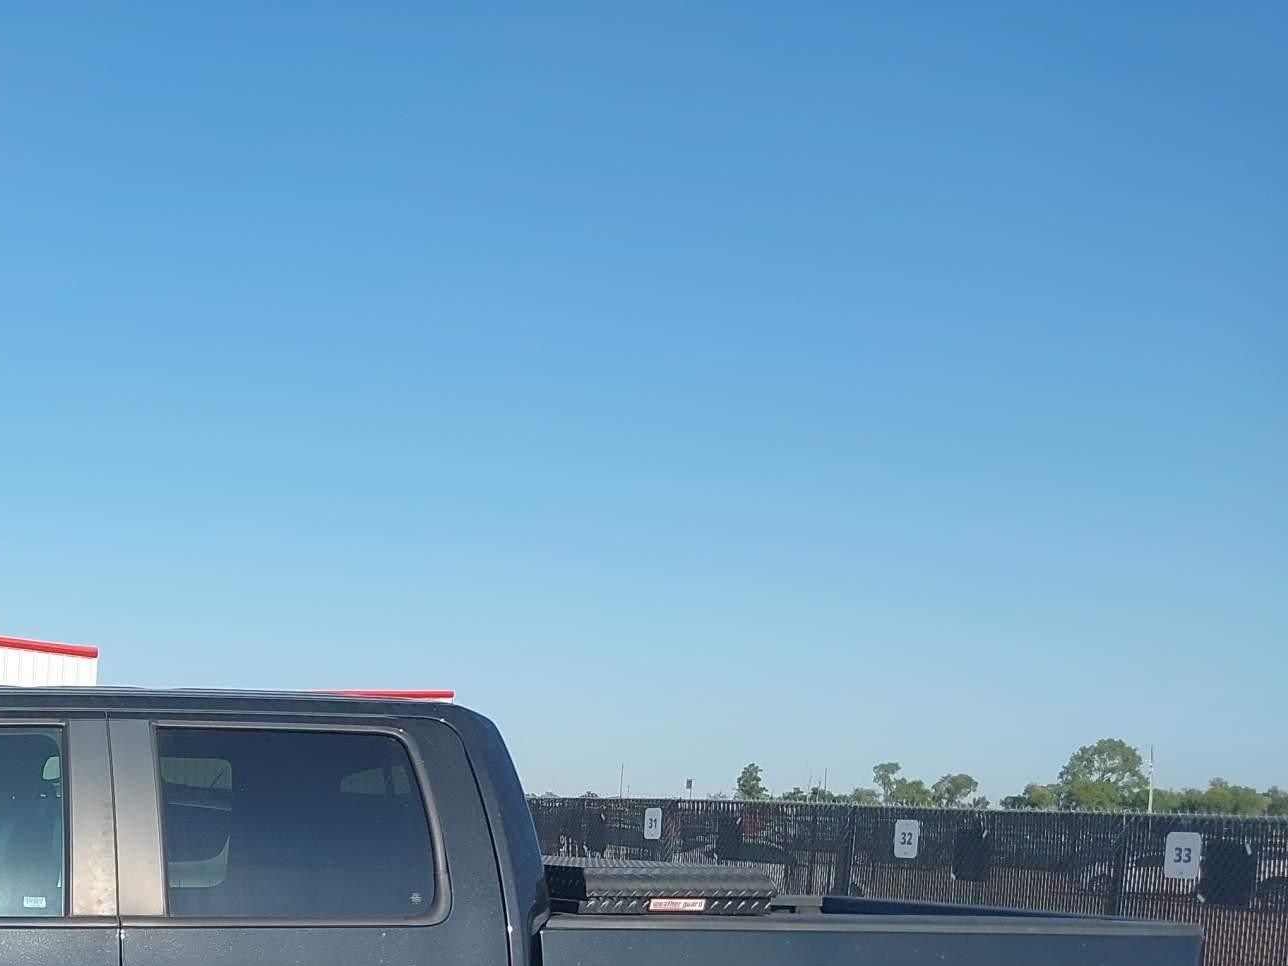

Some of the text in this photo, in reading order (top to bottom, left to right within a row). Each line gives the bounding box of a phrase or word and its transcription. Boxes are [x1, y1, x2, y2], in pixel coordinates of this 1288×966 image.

[648, 818, 658, 829] 31
[900, 832, 913, 846] 32
[1173, 847, 1192, 864] 33
[683, 900, 703, 908] guard
